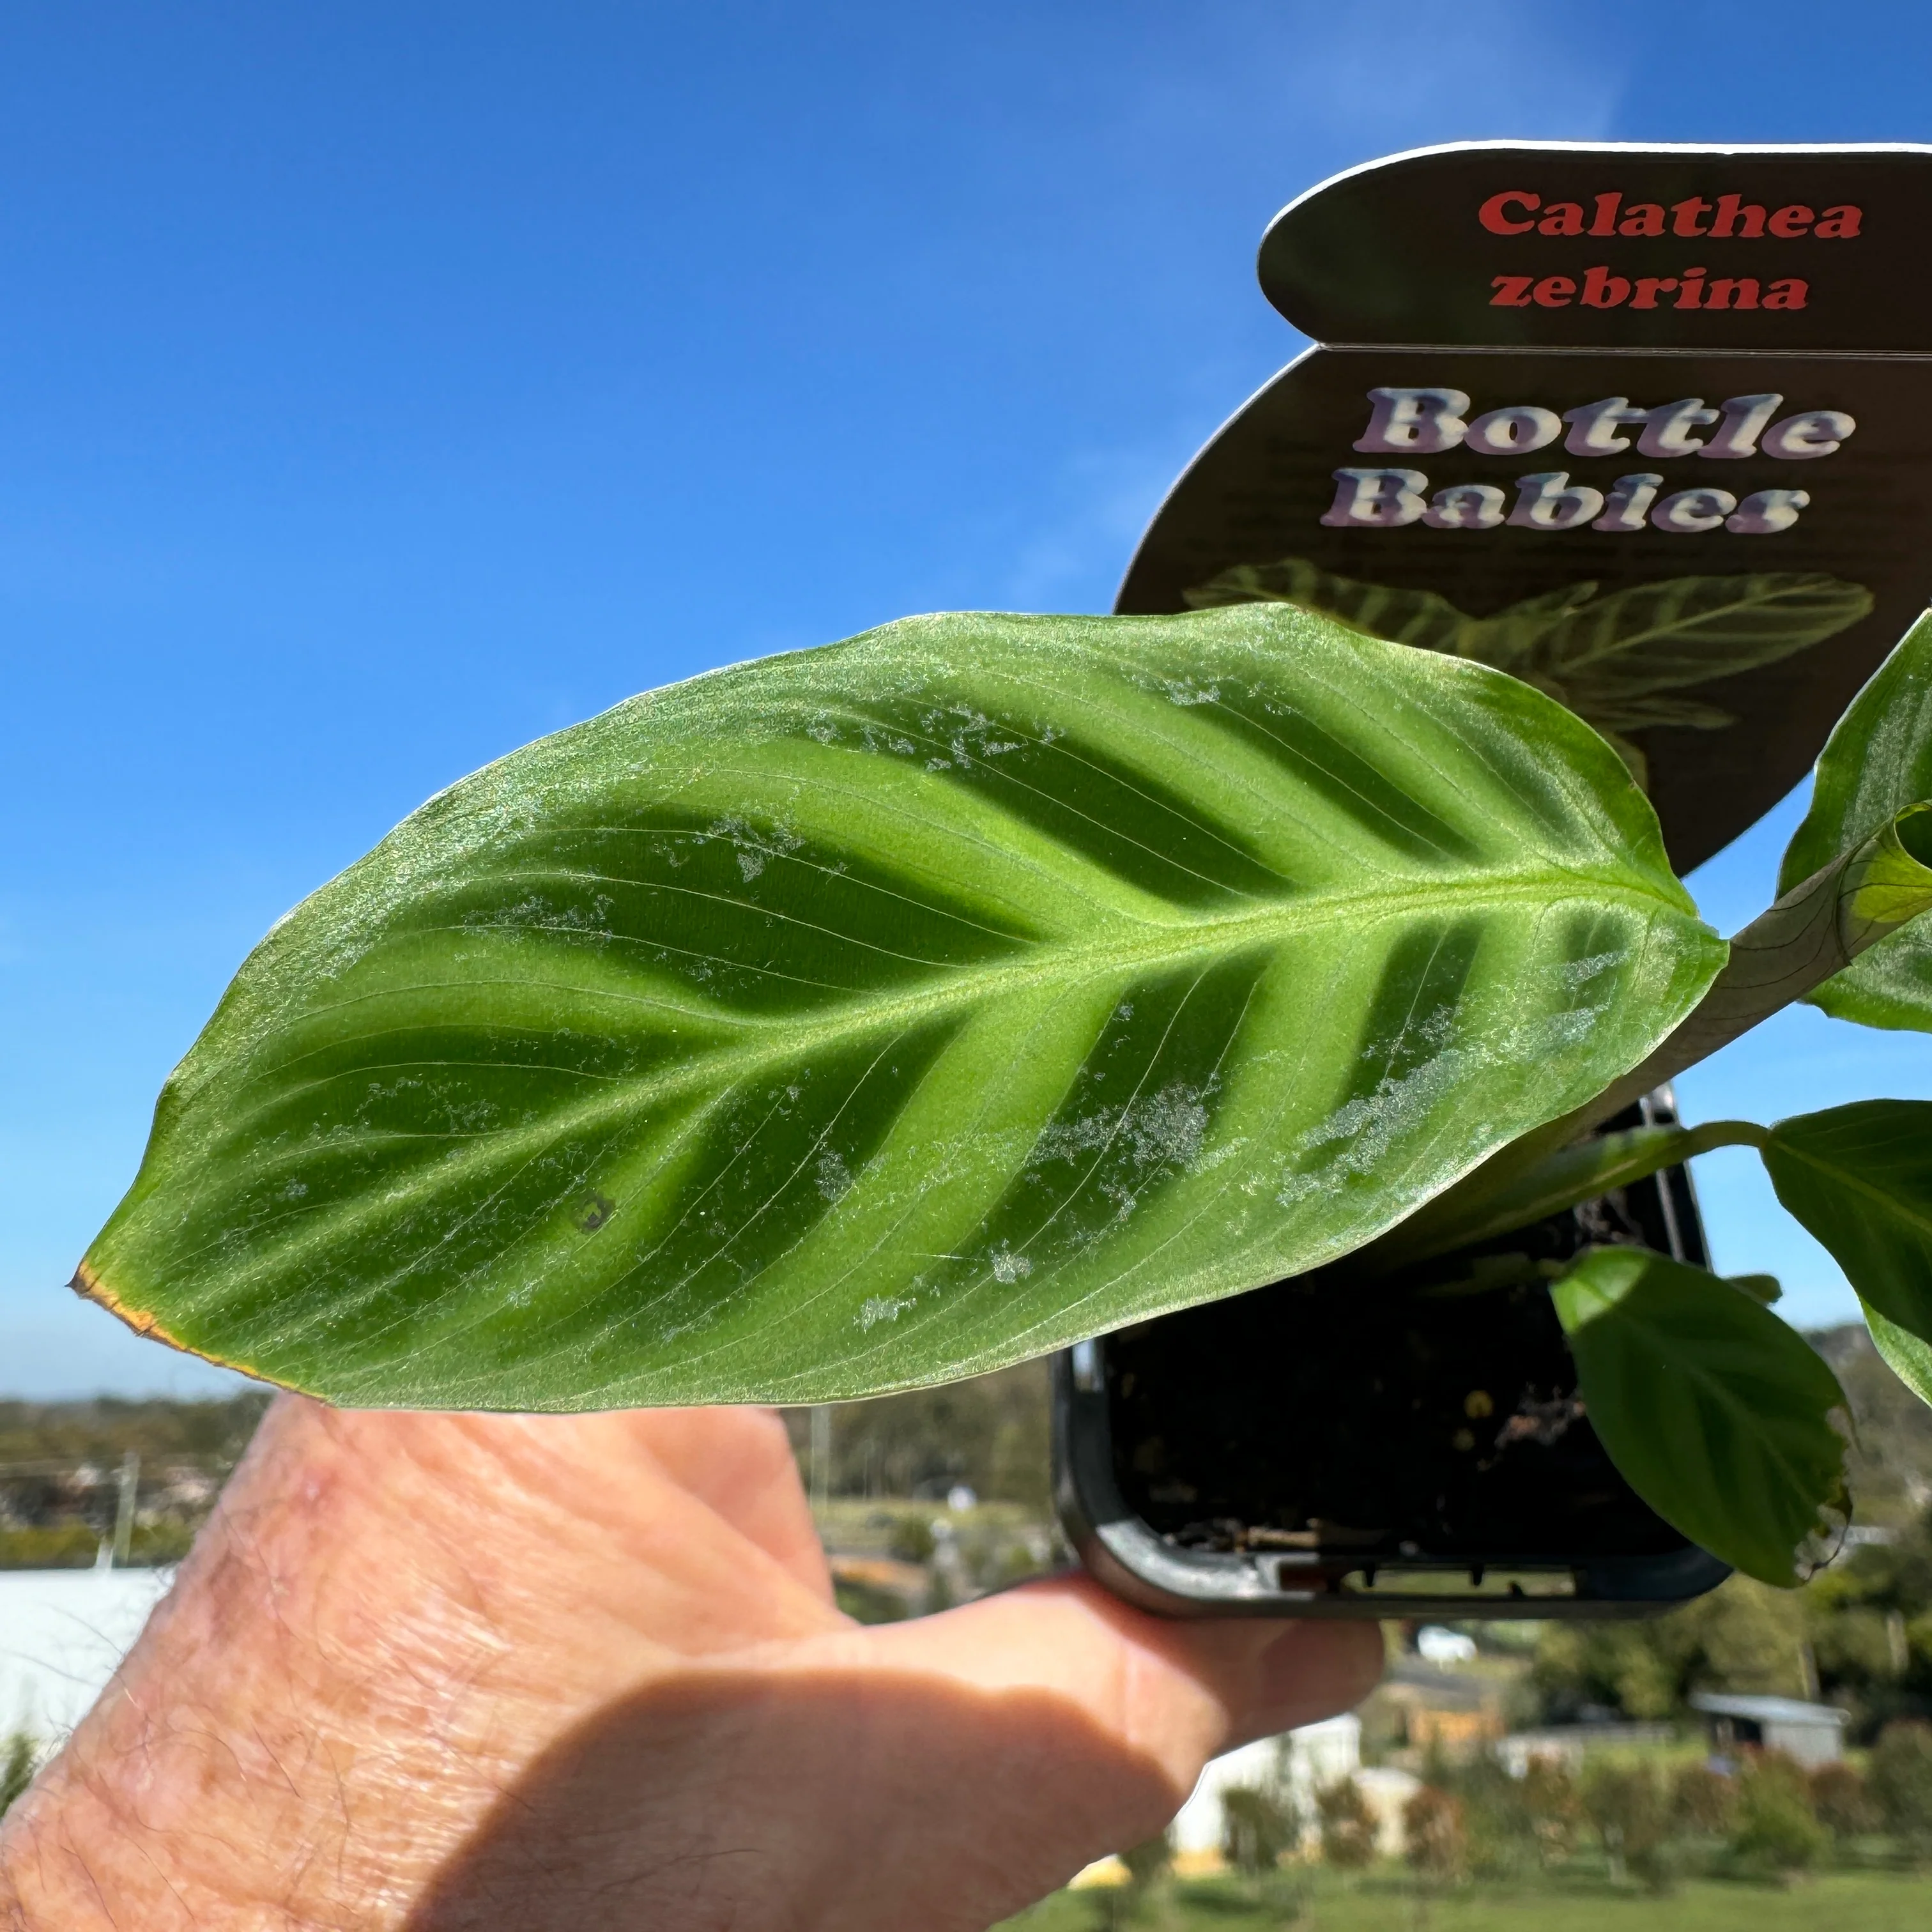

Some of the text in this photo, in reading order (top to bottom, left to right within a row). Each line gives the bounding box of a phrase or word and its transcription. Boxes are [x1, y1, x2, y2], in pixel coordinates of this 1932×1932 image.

[1478, 191, 1862, 238] Calathea
[1489, 266, 1809, 310] zebrina
[1353, 387, 1856, 459] Bottle
[1320, 467, 1811, 533] Babies
